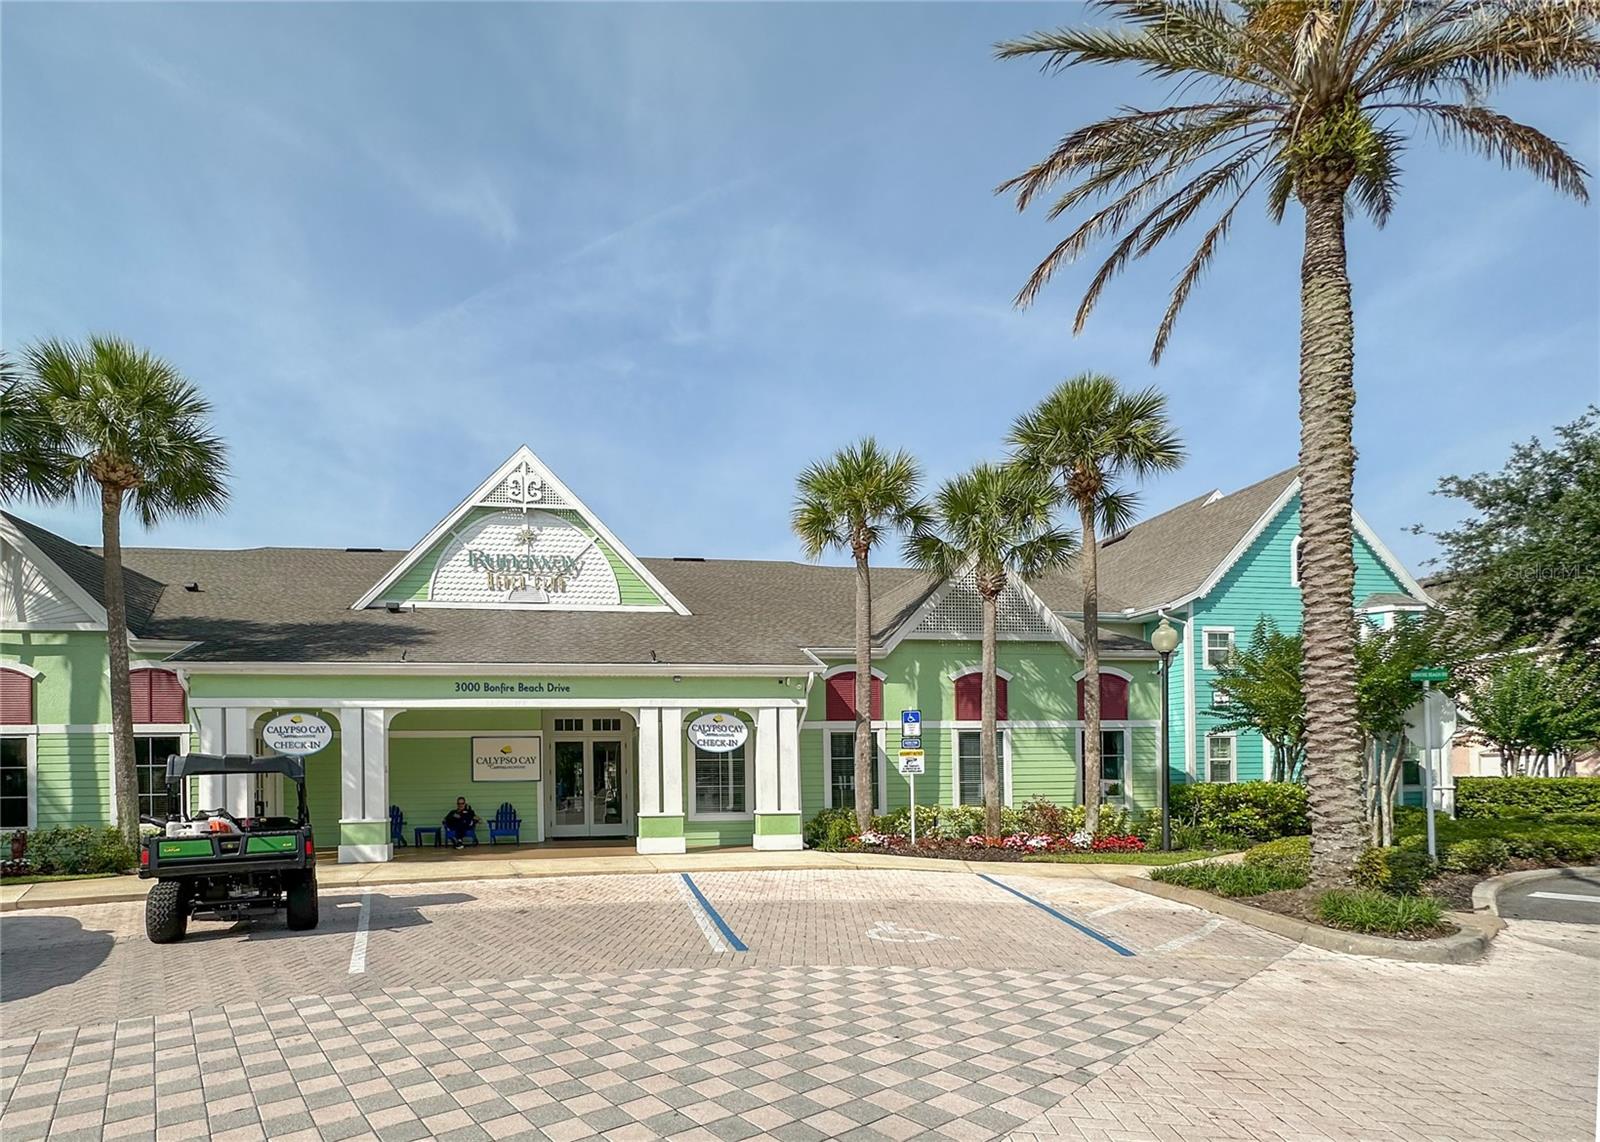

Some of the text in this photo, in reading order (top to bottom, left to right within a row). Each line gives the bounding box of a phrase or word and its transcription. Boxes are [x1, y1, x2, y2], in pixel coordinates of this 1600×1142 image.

[455, 682, 571, 694] 3000 Bonfire Beach Drive
[266, 725, 326, 734] CALYPSO CAY
[691, 724, 744, 733] CALYPSO CAY
[273, 741, 320, 749] CHECK-IN
[697, 739, 738, 747] CHECK-IN
[475, 756, 536, 765] CALYPSO CAY
